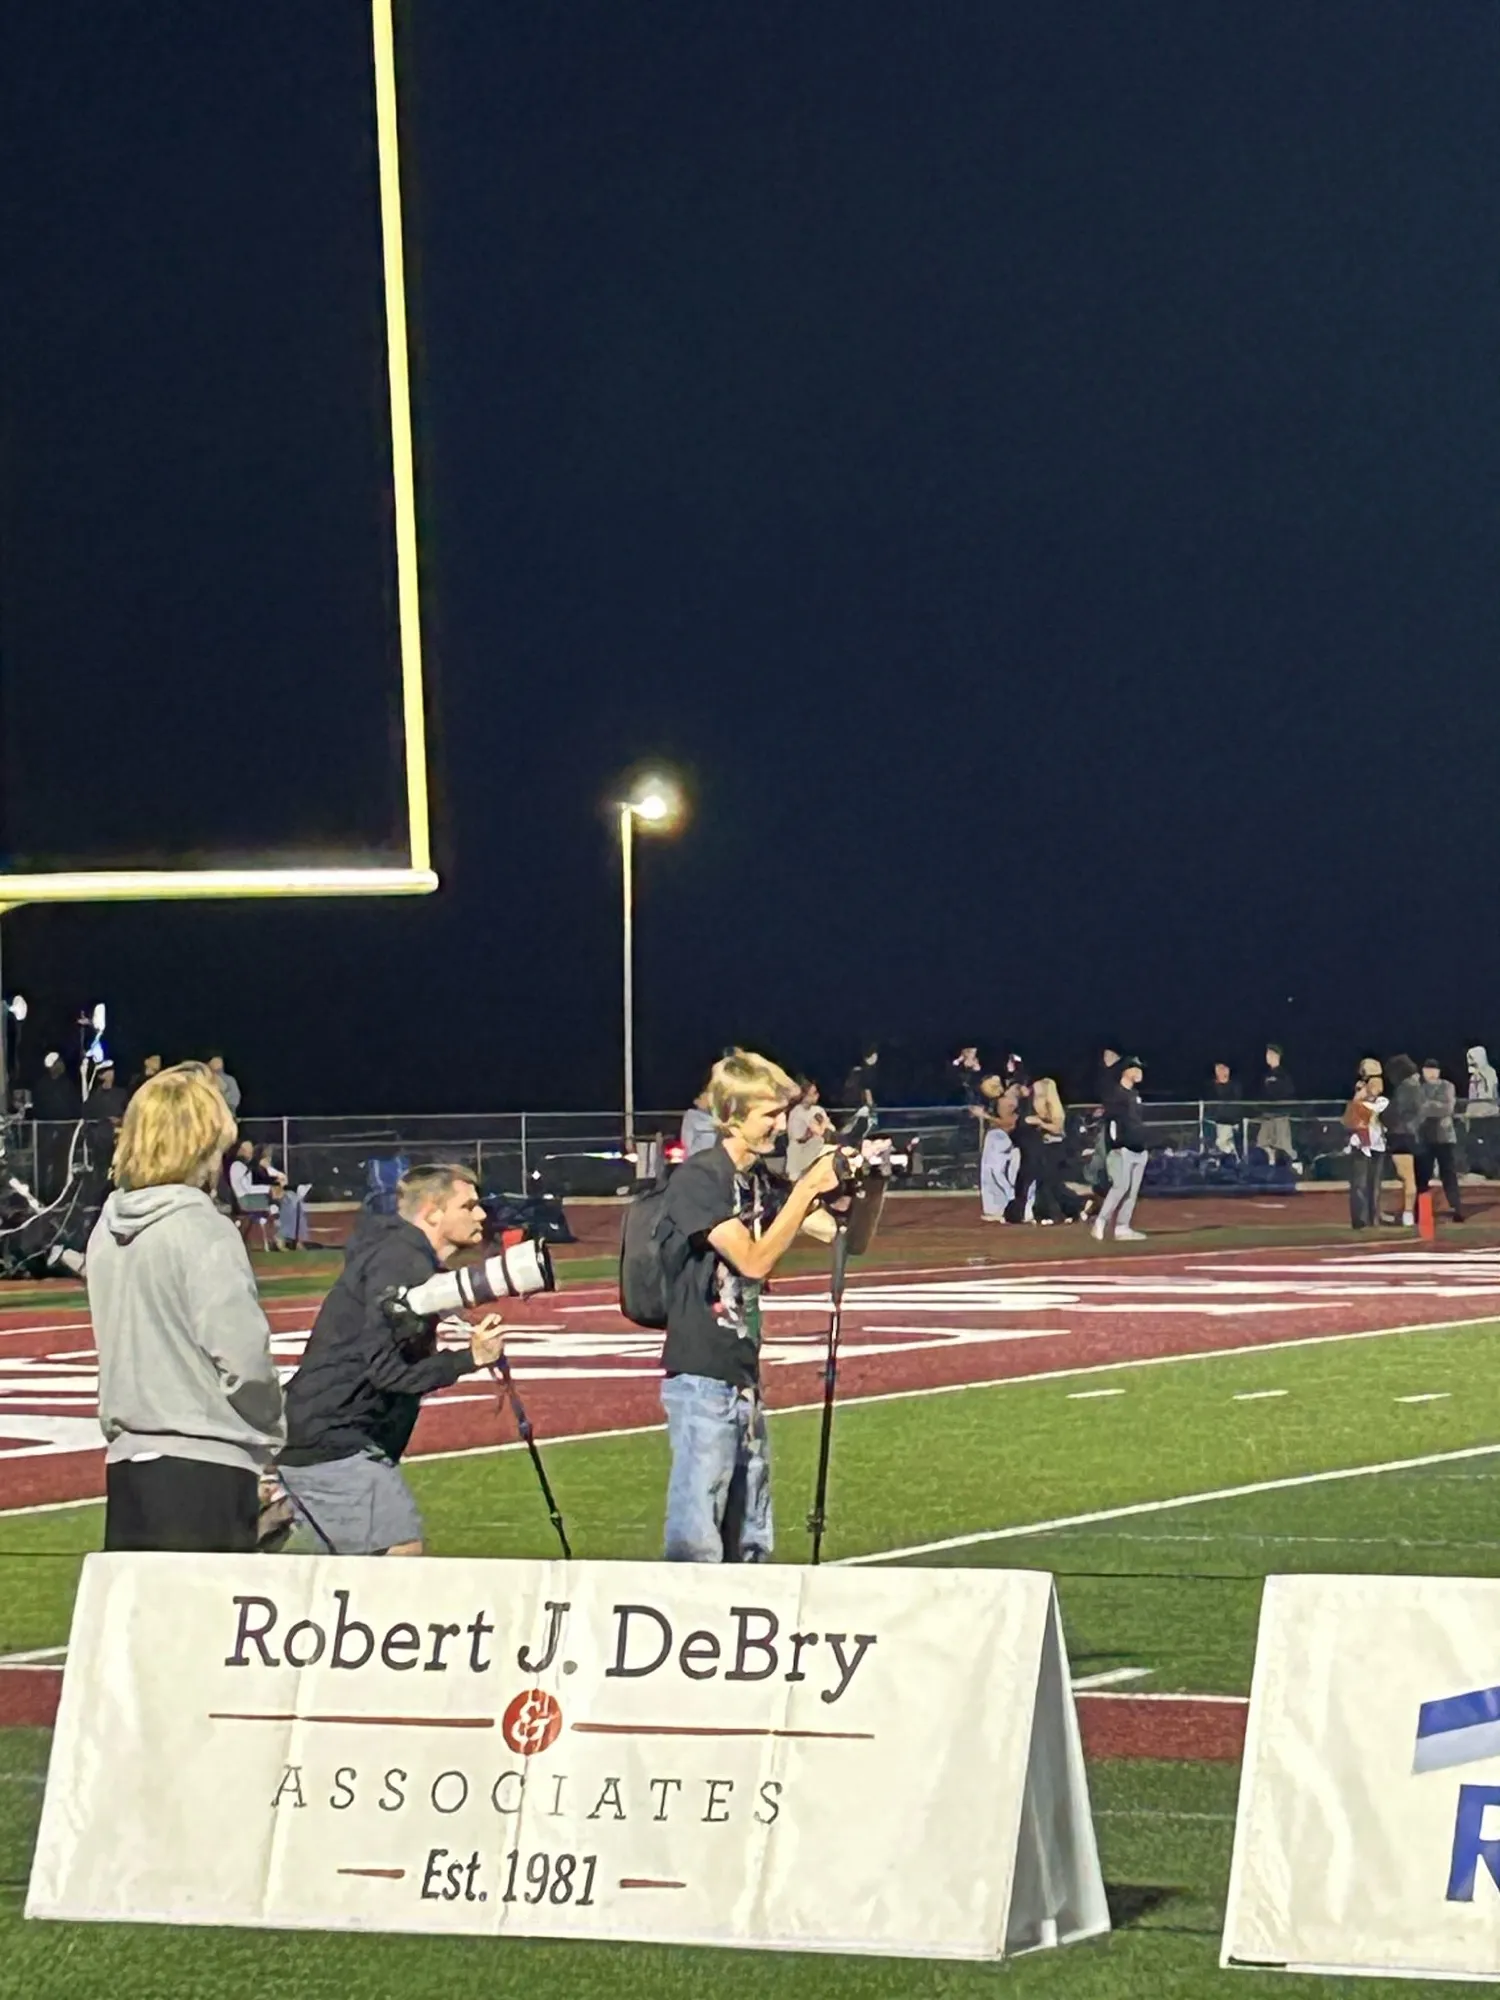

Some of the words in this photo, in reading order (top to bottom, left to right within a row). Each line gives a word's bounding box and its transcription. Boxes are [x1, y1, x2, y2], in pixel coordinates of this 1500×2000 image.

[225, 1589, 495, 1672] Robert
[517, 1600, 578, 1674] J.
[605, 1604, 878, 1704] DeBry
[508, 1689, 561, 1753] &
[270, 1764, 783, 1825] ASSOCIATES
[420, 1848, 487, 1902] Est.
[502, 1849, 598, 1906] 1981
